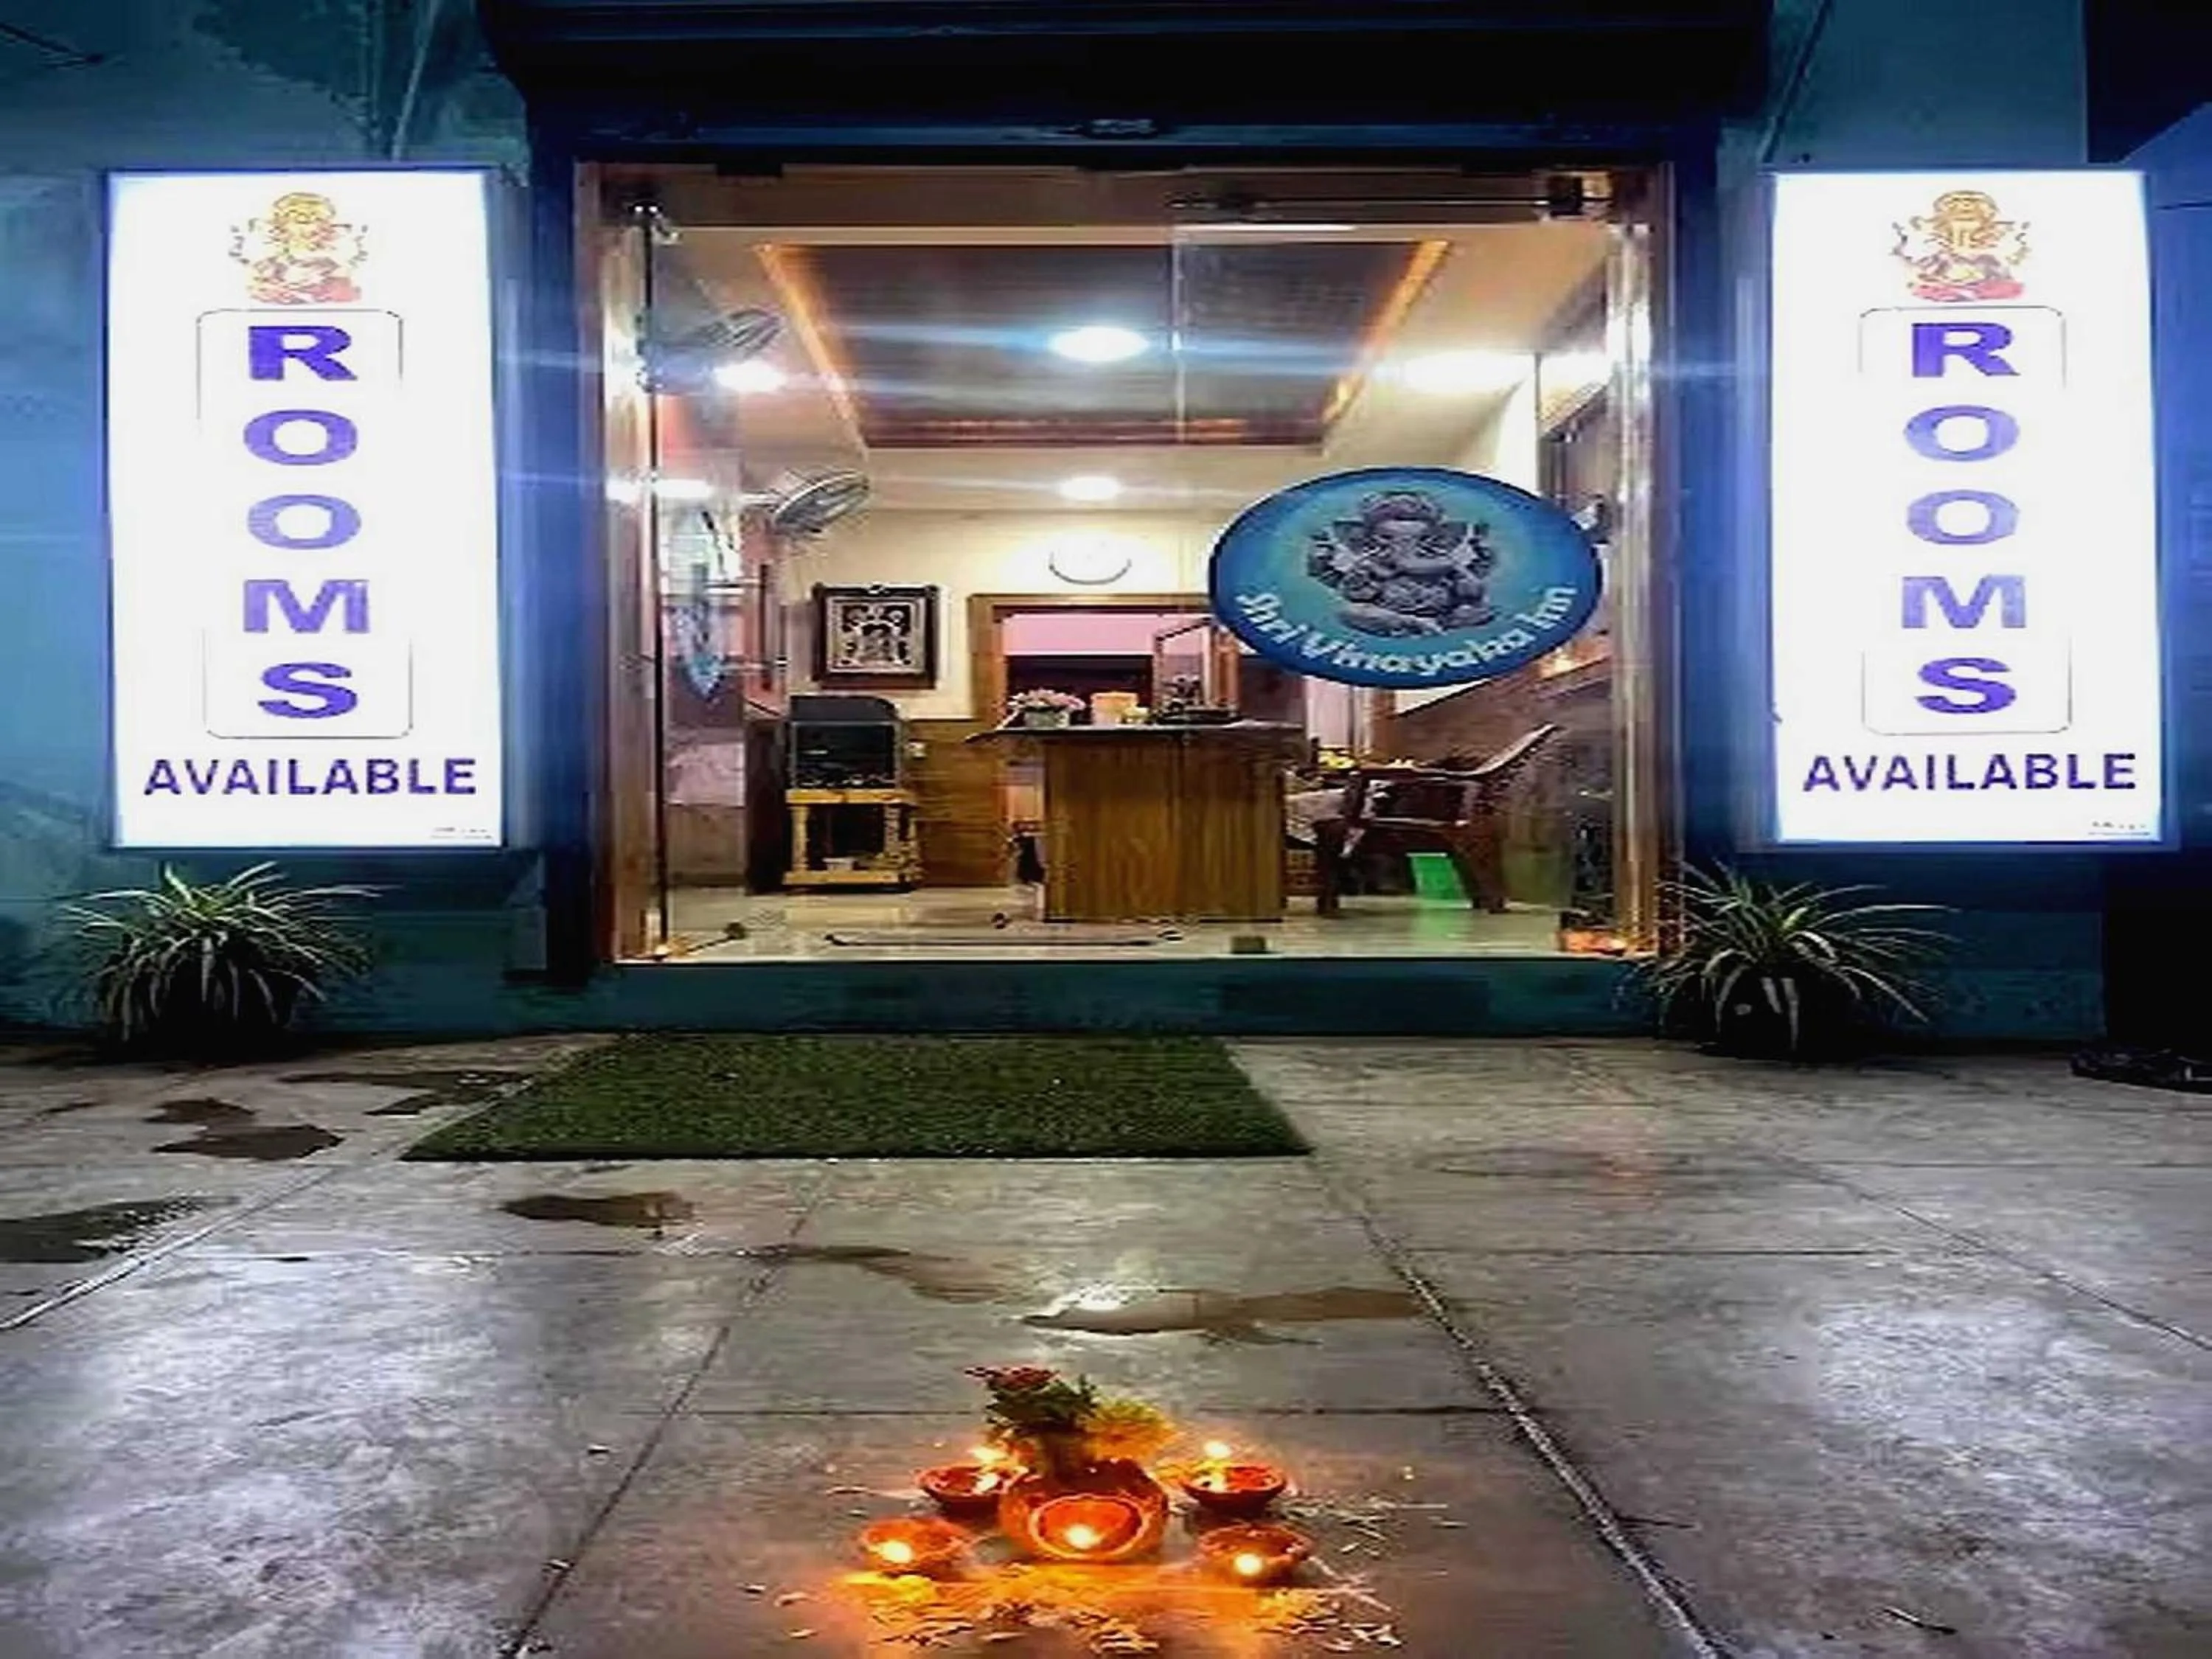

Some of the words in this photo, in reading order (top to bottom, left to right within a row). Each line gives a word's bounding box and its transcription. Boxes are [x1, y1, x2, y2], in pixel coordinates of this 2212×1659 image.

[243, 324, 371, 719] ROOMS
[1902, 321, 2027, 714] ROOMS
[1236, 592, 1310, 644] Shri
[1514, 587, 1578, 629] Inn
[145, 757, 477, 795] AVAILABLE
[1803, 754, 2136, 791] AVAILABLE
